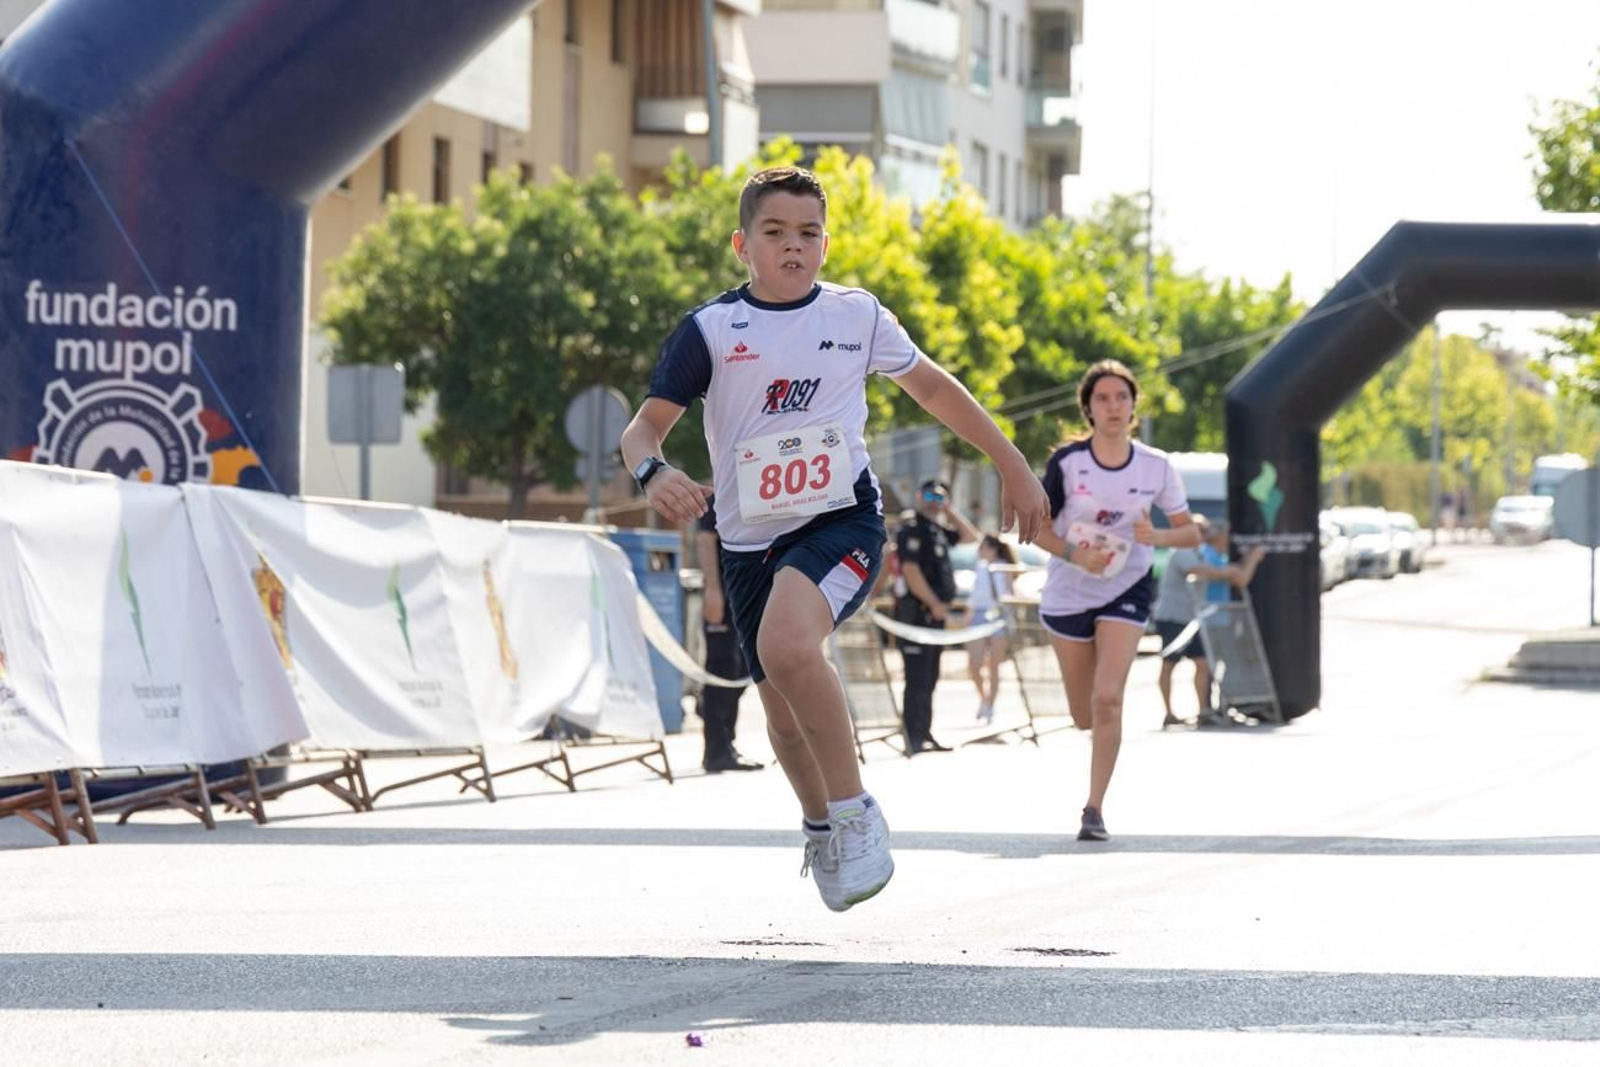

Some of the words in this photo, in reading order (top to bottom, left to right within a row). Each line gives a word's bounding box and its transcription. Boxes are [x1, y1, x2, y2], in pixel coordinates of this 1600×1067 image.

[25, 280, 237, 332] fundación
[55, 331, 192, 381] mupol
[723, 352, 760, 364] Santander
[838, 341, 862, 352] mupol
[759, 453, 831, 501] 803
[851, 550, 870, 568] FILA
